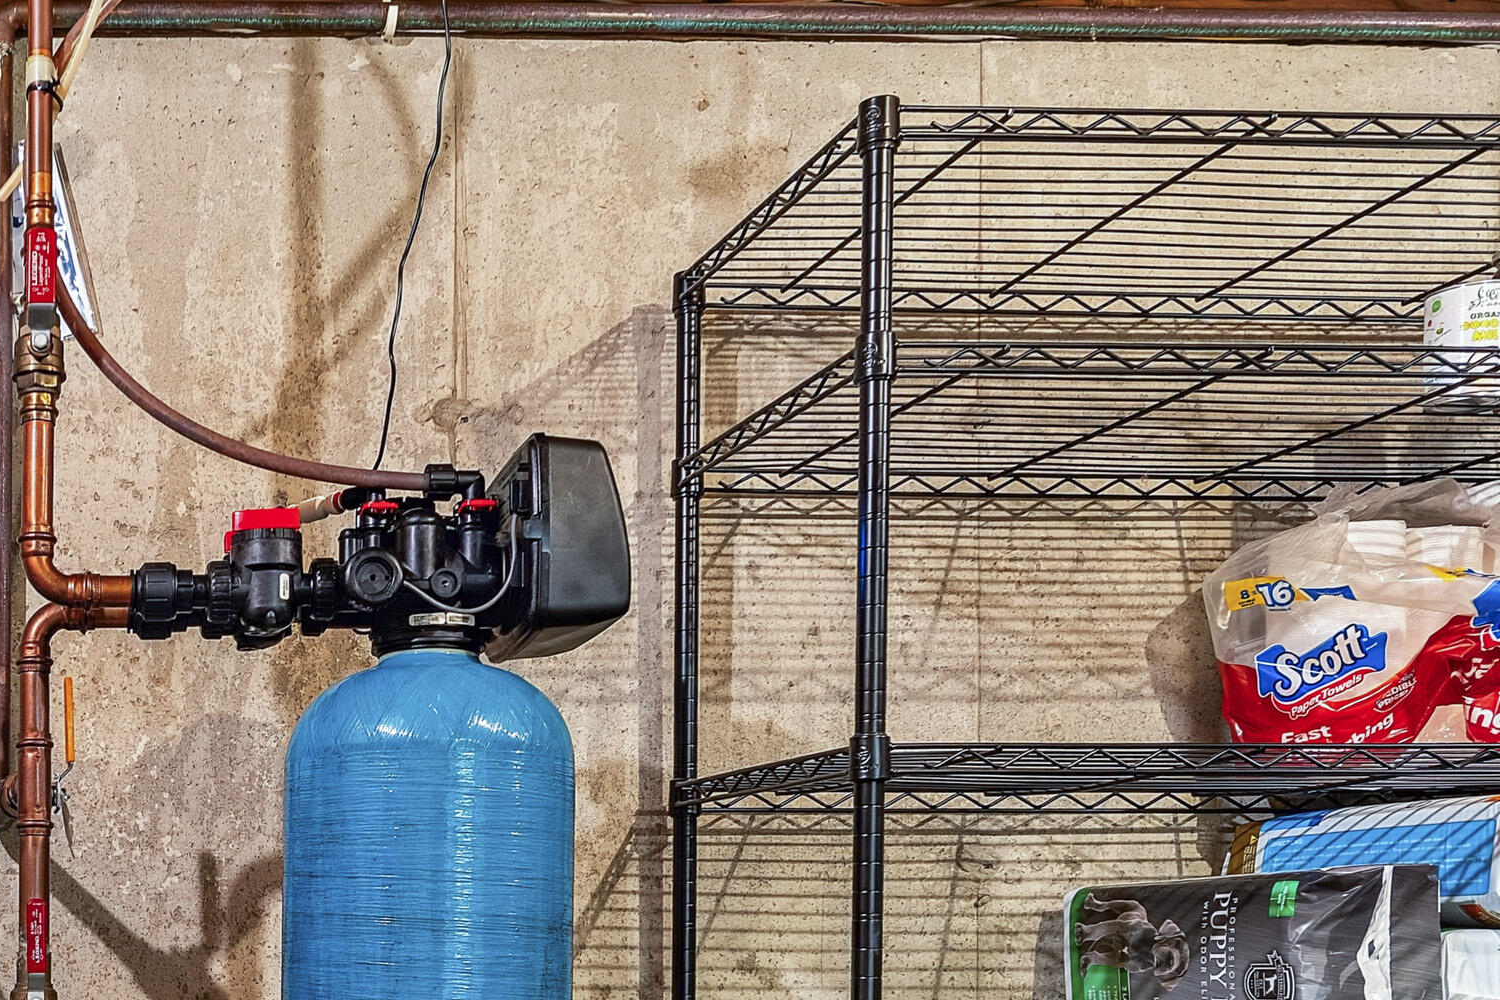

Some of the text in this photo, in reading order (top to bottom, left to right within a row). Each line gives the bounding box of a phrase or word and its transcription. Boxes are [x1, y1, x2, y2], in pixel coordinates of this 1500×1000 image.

[1240, 590, 1250, 599] 8
[1256, 580, 1294, 606] 16
[1273, 625, 1362, 698] Scott
[1291, 674, 1363, 716] Paper Towels
[1281, 726, 1332, 743] Fast
[1201, 901, 1210, 929] with
[1200, 936, 1210, 973] ODOR
[1209, 891, 1233, 988] PUPPY
